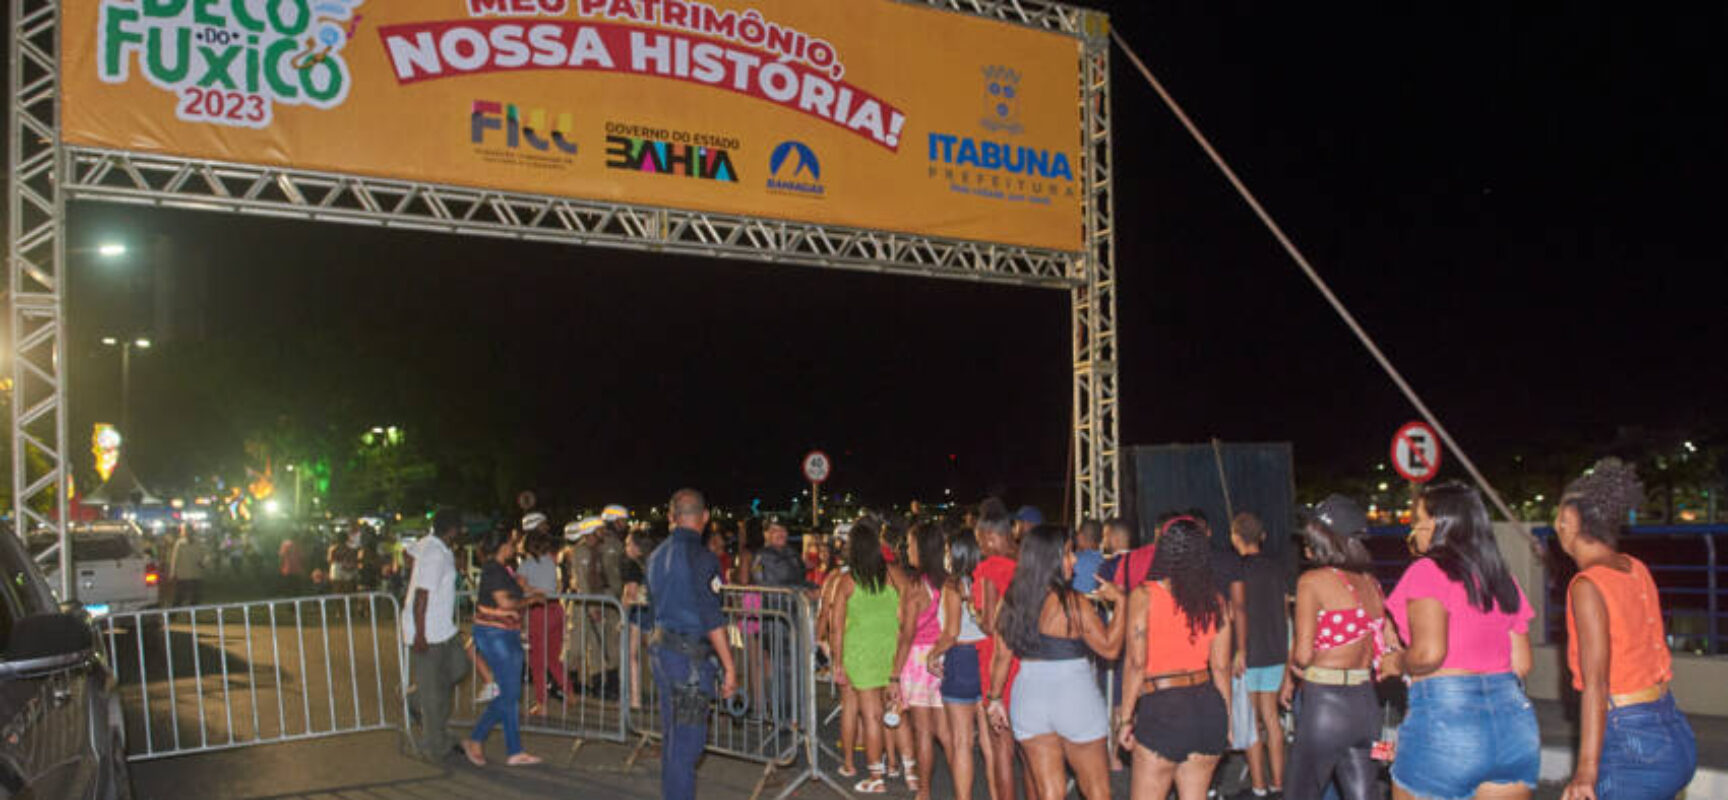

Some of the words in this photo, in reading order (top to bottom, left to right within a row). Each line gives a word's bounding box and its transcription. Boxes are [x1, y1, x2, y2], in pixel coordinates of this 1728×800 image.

[184, 87, 265, 121] 2023
[387, 24, 614, 79] NOSSA
[630, 32, 905, 147] HISTÓRIA!
[605, 121, 669, 139] GOVERNO
[672, 130, 691, 142] DO
[693, 133, 740, 149] ESTADO
[929, 132, 1074, 181] ITABUNA
